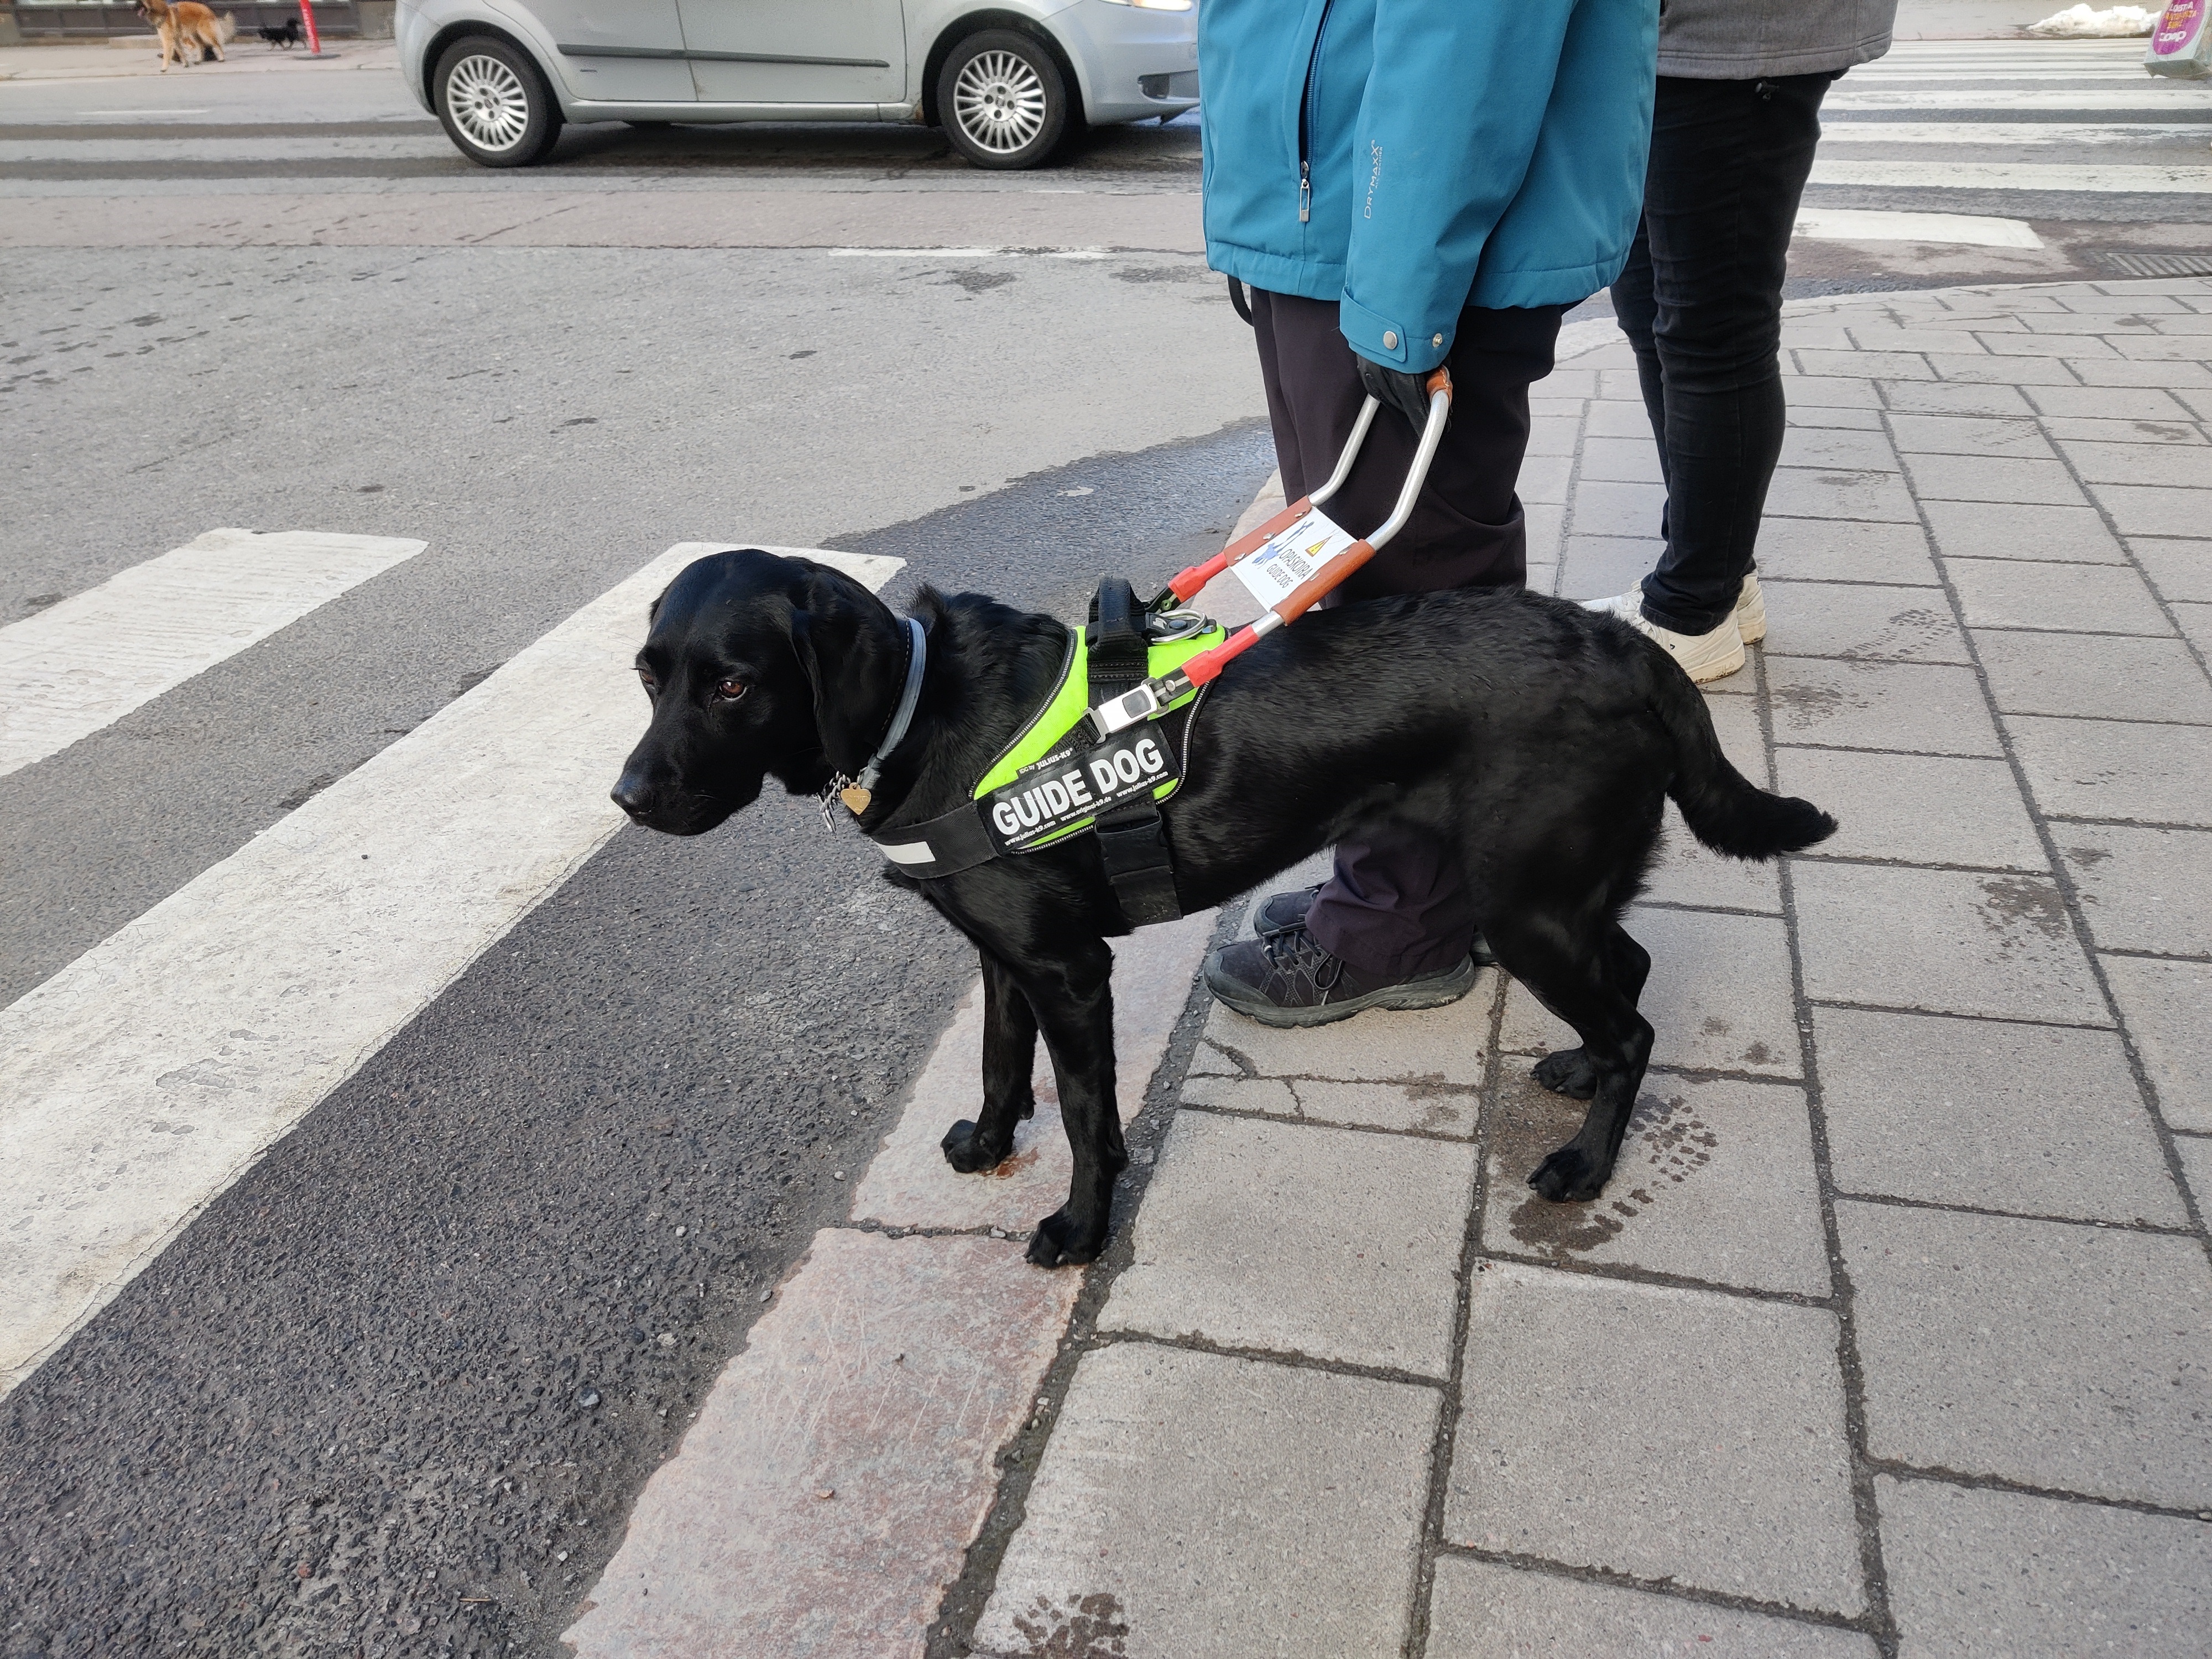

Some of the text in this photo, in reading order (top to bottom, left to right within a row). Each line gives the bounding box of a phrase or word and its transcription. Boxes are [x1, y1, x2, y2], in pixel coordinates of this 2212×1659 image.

[1266, 564, 1293, 588] GUIDE DOG
[1279, 549, 1313, 580] OPASKOIRA
[1714, 661, 1735, 673] FILA
[993, 738, 1164, 836] GUIDE DOG
[1004, 771, 1168, 846] www.julius-k9.com www.original-k9.de www.julius-k9.com
